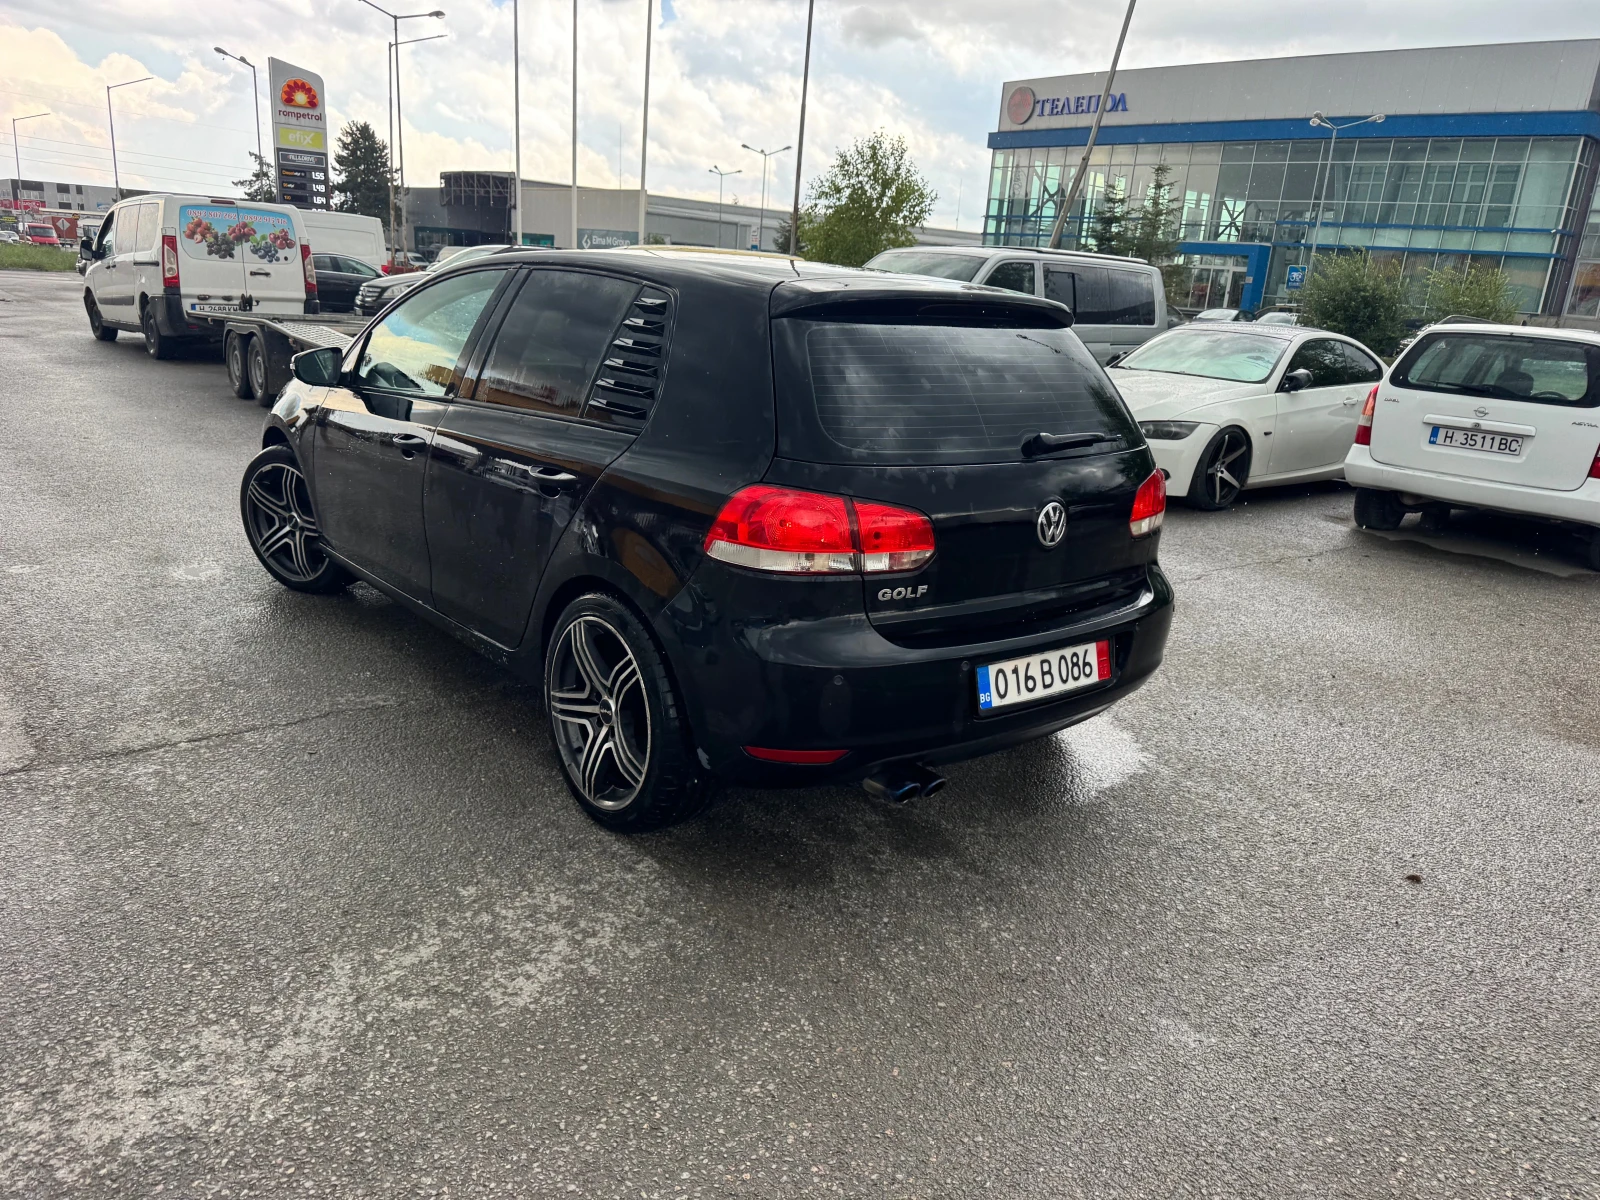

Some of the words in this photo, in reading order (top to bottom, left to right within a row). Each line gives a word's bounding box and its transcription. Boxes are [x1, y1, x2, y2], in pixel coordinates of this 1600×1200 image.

[278, 109, 322, 121] rompetrol
[288, 131, 315, 146] efix
[877, 585, 928, 601] GOLF
[979, 692, 991, 704] BG
